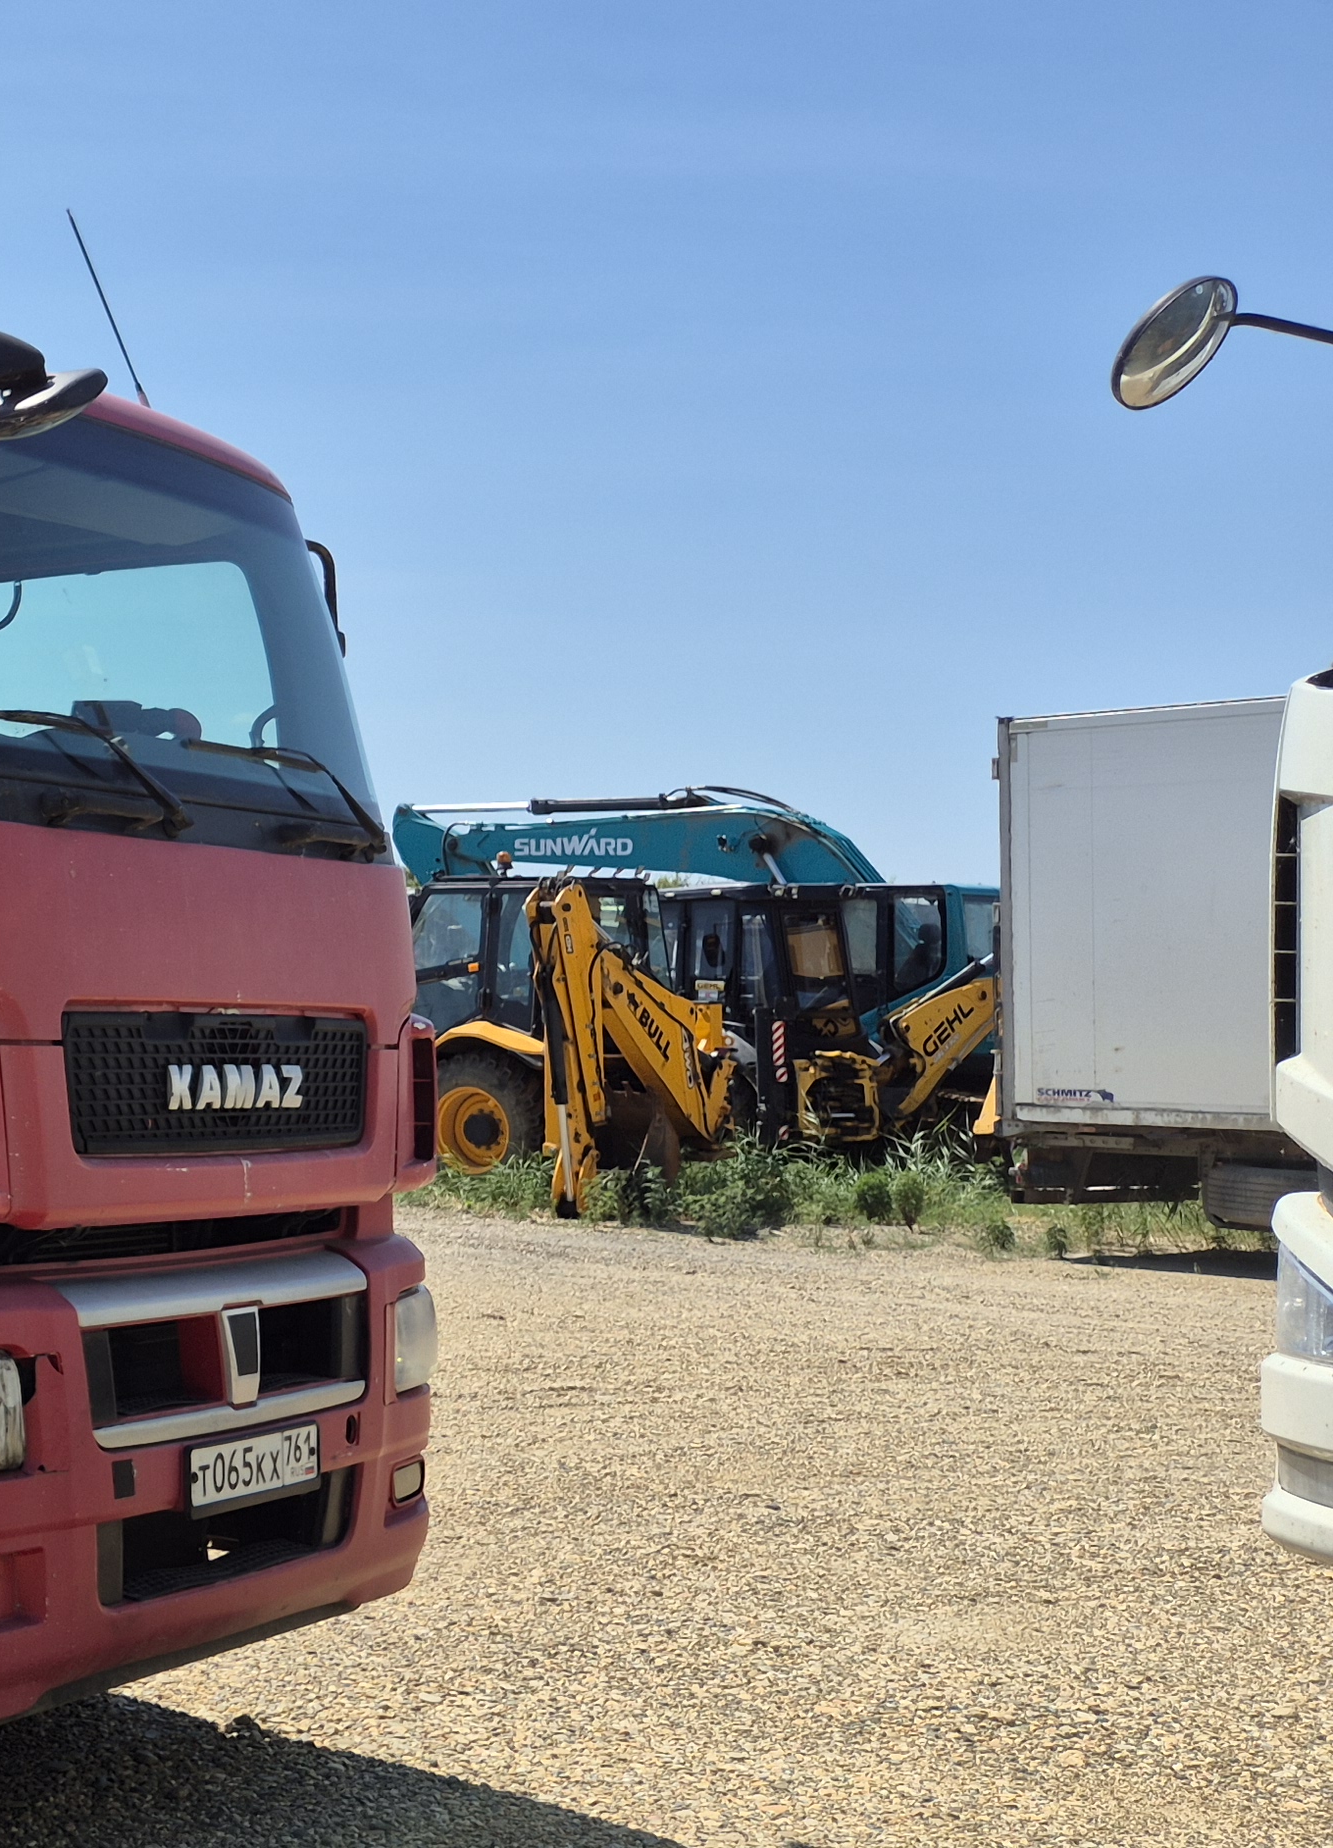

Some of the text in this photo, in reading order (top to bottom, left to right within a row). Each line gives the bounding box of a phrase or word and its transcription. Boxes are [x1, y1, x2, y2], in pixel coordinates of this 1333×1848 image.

[514, 827, 633, 856] SUNWARD
[638, 1007, 671, 1062] BULL
[923, 1003, 975, 1057] GEHL
[167, 1064, 303, 1110] KAMAZ
[1037, 1087, 1092, 1098] SCHMITZ
